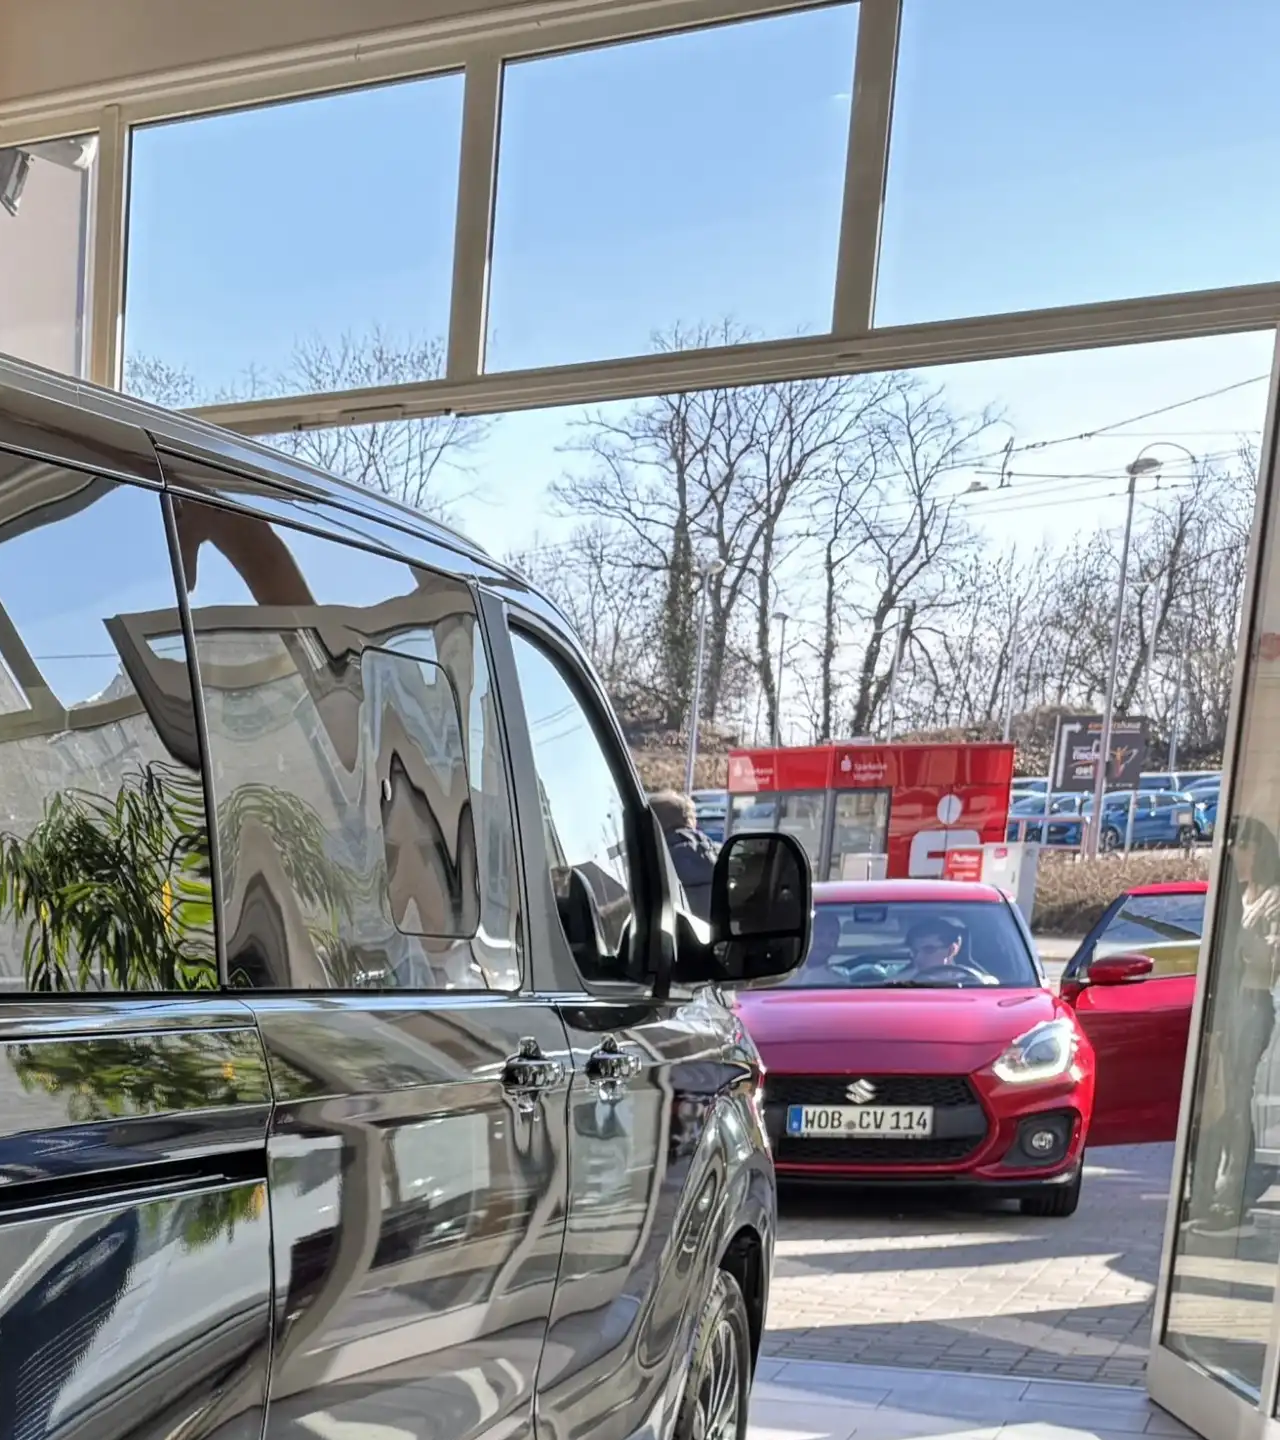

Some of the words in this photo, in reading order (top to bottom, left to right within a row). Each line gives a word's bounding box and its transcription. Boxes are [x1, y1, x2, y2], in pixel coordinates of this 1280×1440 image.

[804, 1110, 842, 1129] WOB
[858, 1110, 885, 1130] CV
[890, 1110, 928, 1131] 114
